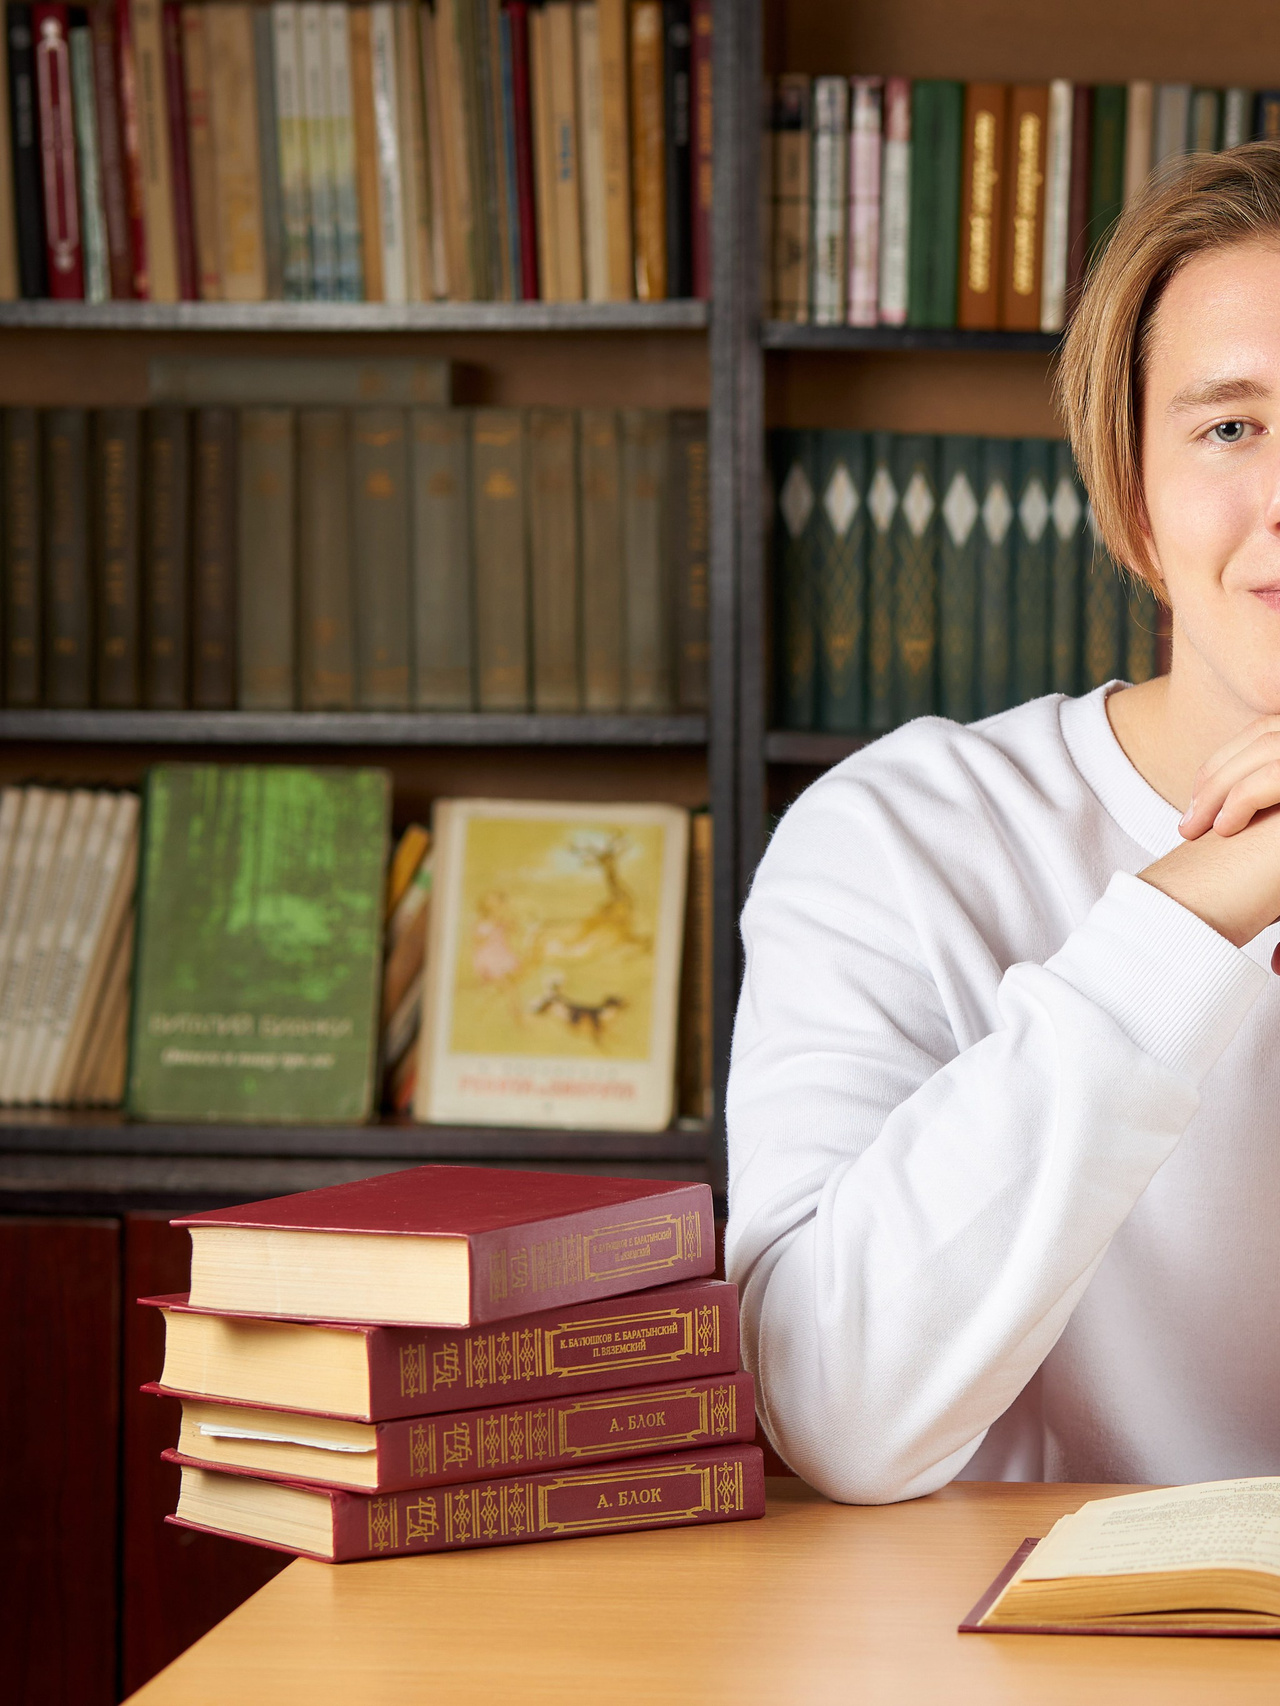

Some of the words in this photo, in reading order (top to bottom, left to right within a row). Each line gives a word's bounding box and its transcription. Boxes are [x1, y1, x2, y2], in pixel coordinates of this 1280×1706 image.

[622, 1322, 678, 1340] БАРАТЫНСКИЙ
[601, 1339, 647, 1356] ВЯЗЕМСКИЙ
[609, 1418, 624, 1432] А.
[628, 1411, 666, 1430] БЛОК
[597, 1493, 613, 1509] А.
[618, 1487, 662, 1506] БЛОК
